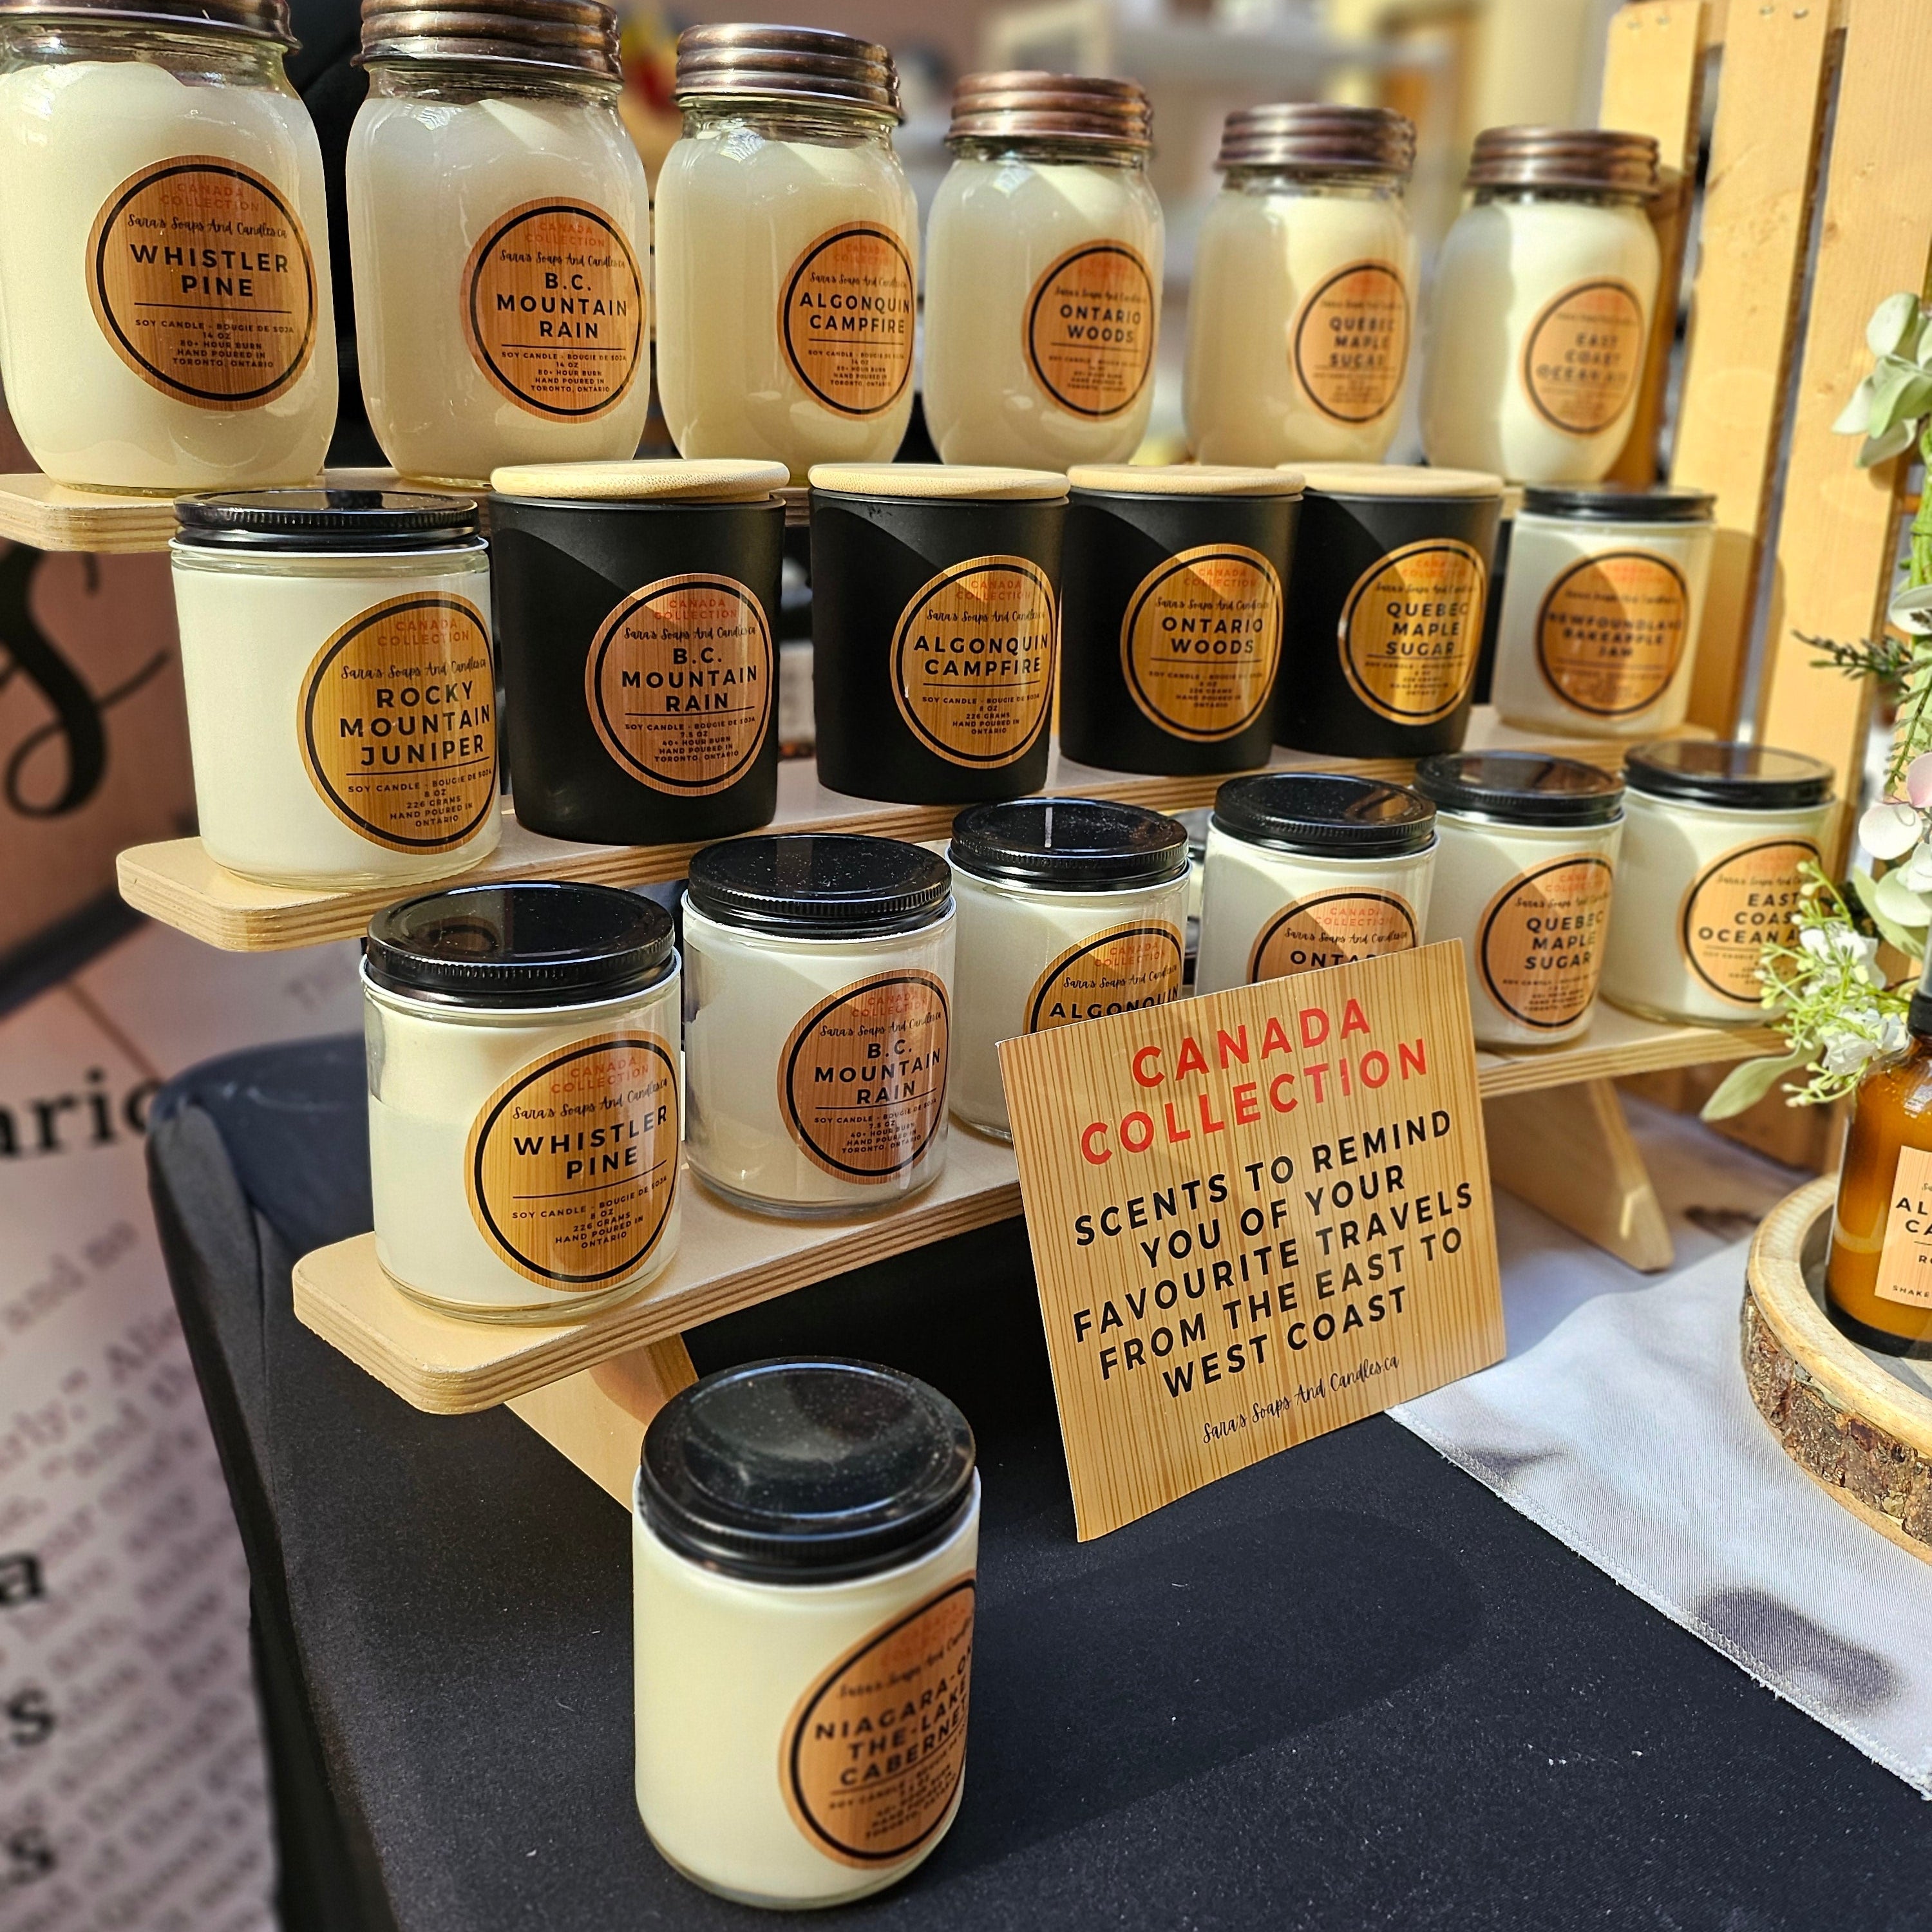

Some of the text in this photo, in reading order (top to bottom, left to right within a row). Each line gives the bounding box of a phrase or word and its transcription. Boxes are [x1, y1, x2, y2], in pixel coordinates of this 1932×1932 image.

[128, 214, 166, 229] Sara's
[171, 217, 204, 232] Soaps
[208, 218, 232, 235] And
[129, 244, 289, 273] WHISTLER
[536, 251, 563, 265] Soaps
[566, 253, 584, 267] And
[181, 276, 253, 296] PINE
[545, 272, 591, 291] B.C.
[497, 294, 627, 317] MOUNTAIN
[799, 292, 910, 314] ALGONQUIN
[1060, 304, 1141, 325] ONTARIO
[135, 319, 156, 328] SOY
[162, 320, 204, 330] CANDLE
[216, 323, 253, 332] BOUGIE
[540, 321, 598, 339] RAIN
[810, 315, 904, 334] CAMPFIRE
[1067, 325, 1134, 343] WOODS
[177, 349, 207, 357] HAND
[231, 360, 273, 368] ONTARIO
[669, 599, 726, 609] CANADA
[1387, 602, 1468, 618] QUEBEC
[396, 620, 457, 632] CANADA
[927, 609, 1009, 625] Sara's Soaps And
[1162, 617, 1263, 634] ONTARIO
[377, 630, 469, 647] COLLECTION
[624, 628, 713, 641] Sara's Soaps And
[1392, 622, 1460, 636] MAPLE
[914, 633, 1048, 654] ALGONQUIN
[1171, 638, 1254, 654] WOODS
[673, 647, 723, 665] B.C.
[341, 661, 447, 680] Sara's Soaps And
[925, 657, 1041, 676] CAMPFIRE
[622, 665, 757, 688] MOUNTAIN
[377, 680, 473, 708] ROCKY
[666, 693, 728, 712] RAIN
[340, 704, 490, 738] MOUNTAIN
[361, 734, 484, 766] JUNIPER
[348, 784, 370, 793] SOY
[376, 782, 420, 792] CANDLE
[406, 796, 460, 809] 226 GRAMS
[390, 811, 421, 820] HAND
[425, 806, 463, 817] POURED
[415, 815, 459, 827] ONTARIO
[1748, 892, 1799, 907] EAST
[1526, 911, 1604, 933] QUEBEC
[1532, 931, 1595, 951] MAPLE
[1698, 926, 1779, 943] OCEAN
[1525, 952, 1591, 969] SUGAR
[1063, 977, 1126, 989] Sara's Soaps
[820, 1021, 906, 1039] Sara's Soaps And
[867, 1039, 911, 1059] B.C.
[1132, 998, 1371, 1088] CANADA
[571, 1056, 636, 1078] CANADA
[815, 1048, 940, 1083] MOUNTAIN
[551, 1063, 648, 1094] COLLECTION
[857, 1080, 915, 1104] RAIN
[513, 1106, 555, 1120] Sara's
[561, 1103, 596, 1117] Soaps
[600, 1096, 623, 1110] And
[1081, 1039, 1427, 1165] COLLECTION
[513, 1105, 667, 1156] WHISTLER
[567, 1146, 638, 1180] PINE
[1075, 1109, 1452, 1247] SCENTS TO REMIND
[541, 1206, 586, 1218] CANDLE
[600, 1192, 635, 1209] BOUGIE
[639, 1187, 649, 1197] DE
[652, 1175, 667, 1190] SOJA
[574, 1212, 630, 1232] 226 GRAMS
[599, 1208, 614, 1217] OZ
[1141, 1164, 1405, 1268] YOU OF YOUR
[555, 1215, 643, 1244] HAND POURED IN
[582, 1231, 627, 1249] ONTARIO
[1075, 1182, 1473, 1343] FAVOURITE TRAVELS
[1100, 1227, 1463, 1379] FROM THE EAST TO
[1163, 1285, 1406, 1398] WEST COAST
[1203, 1354, 1399, 1444] Sara's Soaps And Candles.ca
